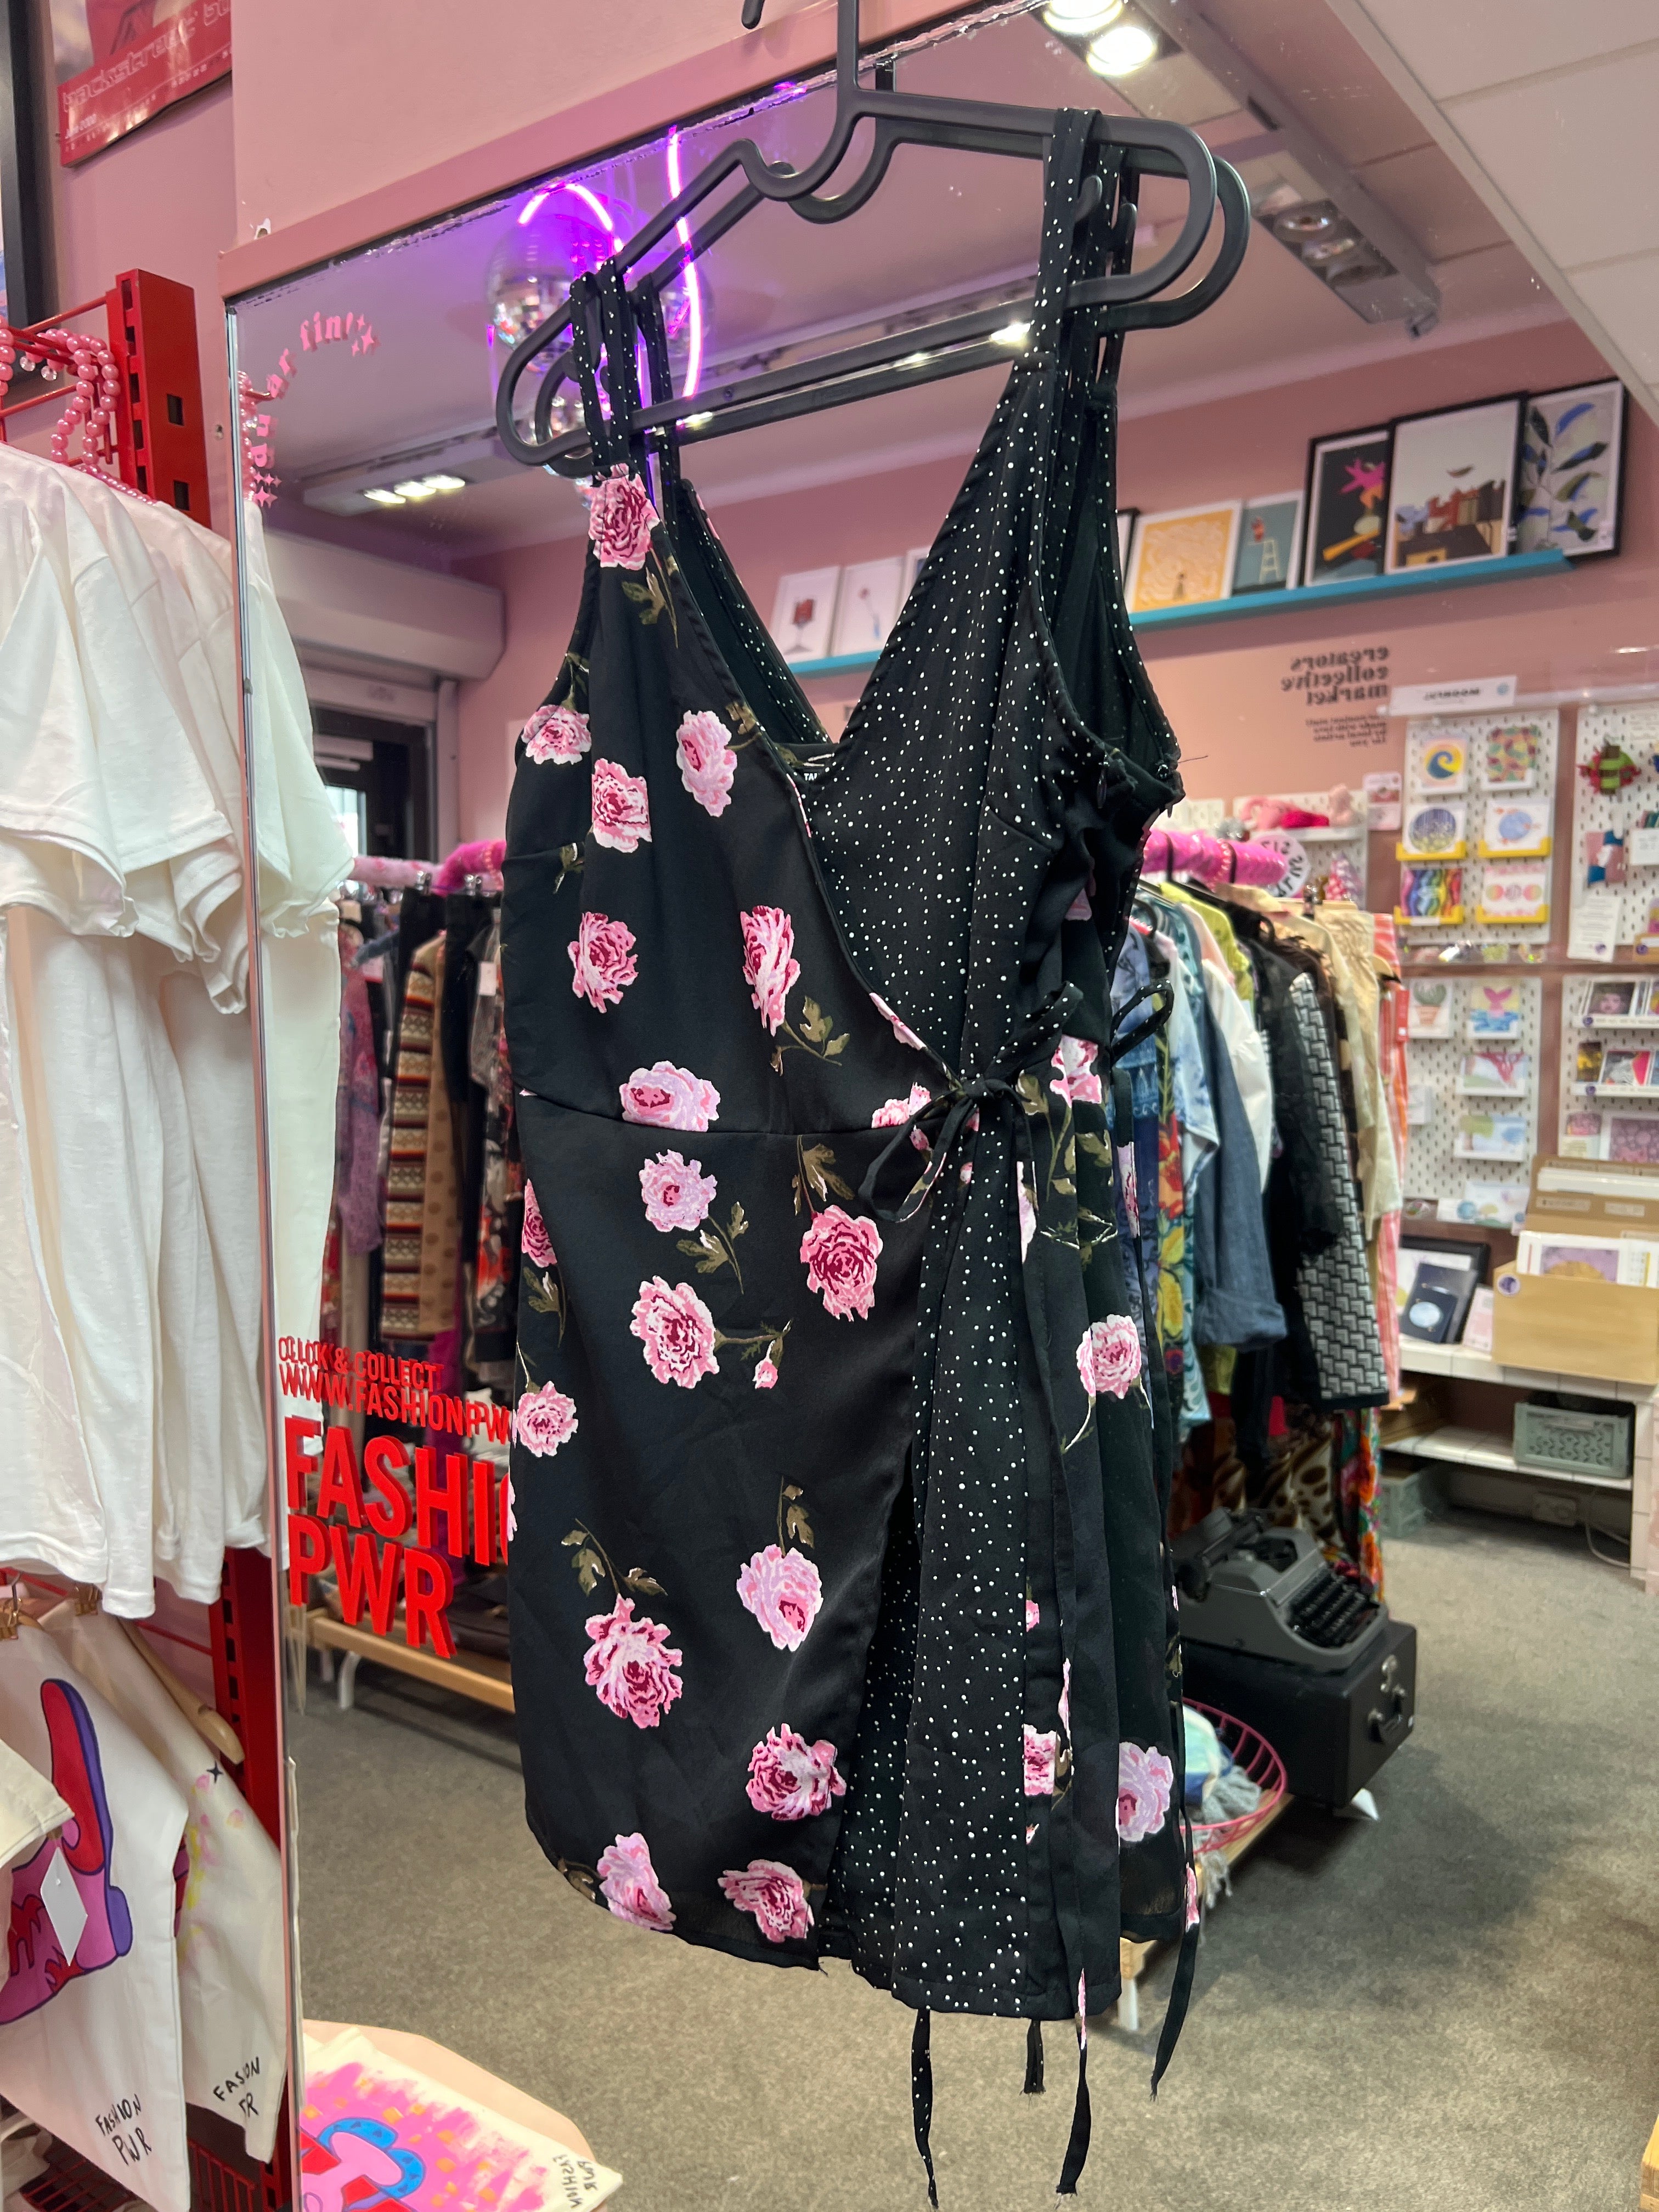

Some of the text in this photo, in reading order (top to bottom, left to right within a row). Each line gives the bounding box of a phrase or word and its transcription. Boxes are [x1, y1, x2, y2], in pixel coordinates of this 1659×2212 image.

[334, 1347, 348, 1374] &
[354, 1352, 437, 1392] COLLECT
[288, 1514, 450, 1659] PWR
[95, 2094, 142, 2136] FASHION
[112, 2128, 152, 2166] PWR
